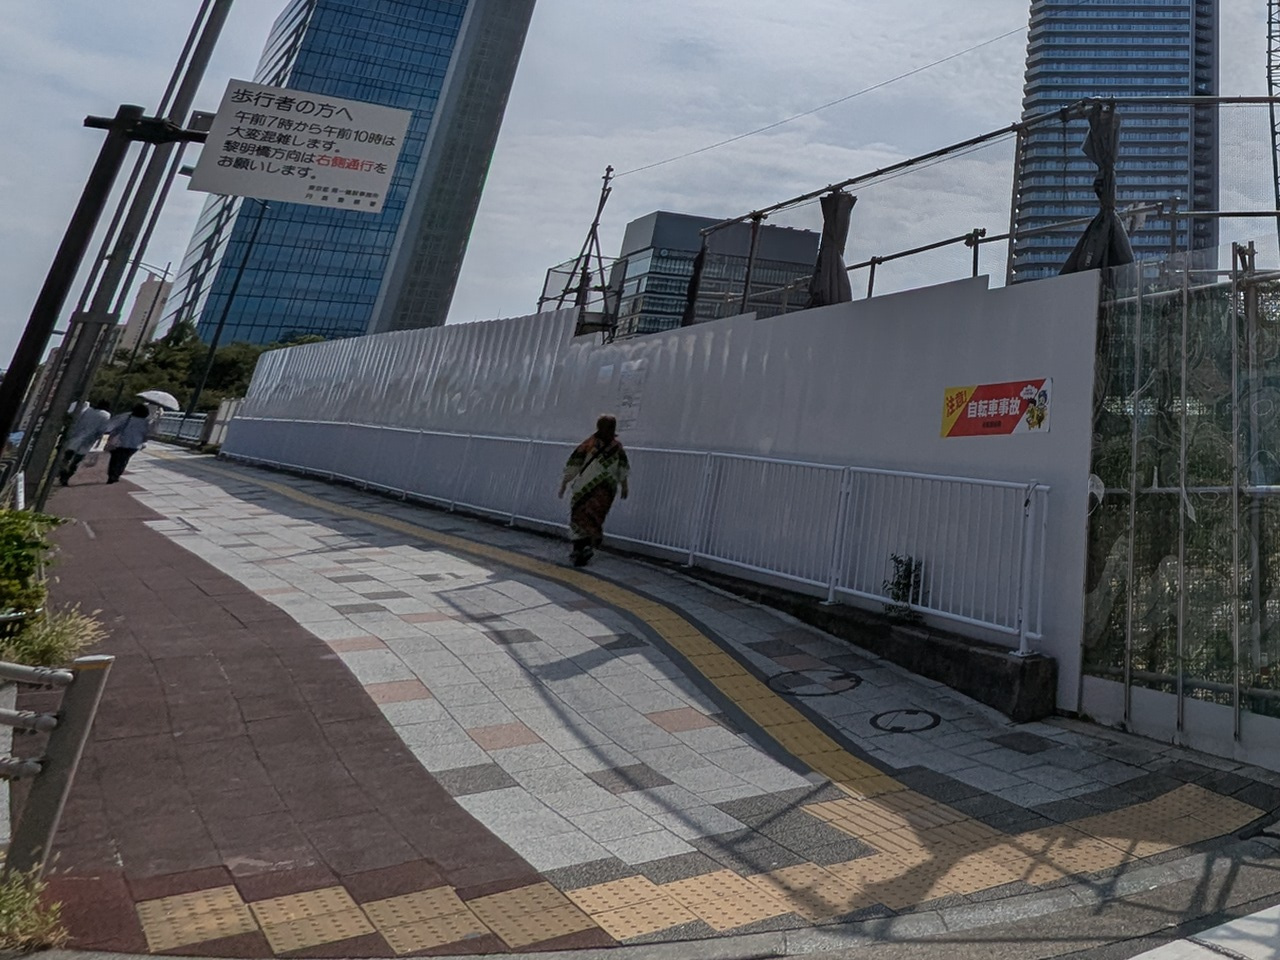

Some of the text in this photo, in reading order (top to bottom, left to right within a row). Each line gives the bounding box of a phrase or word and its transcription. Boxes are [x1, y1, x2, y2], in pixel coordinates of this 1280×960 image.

[230, 88, 353, 121] 歩行者の方へ
[226, 126, 341, 153] 大変混雑します。
[234, 110, 397, 146] 午前7時から午前10時は
[217, 155, 317, 180] お願いします。
[222, 140, 388, 174] 黎明橋方向は右側通行を
[967, 397, 1021, 418] 自転車事故
